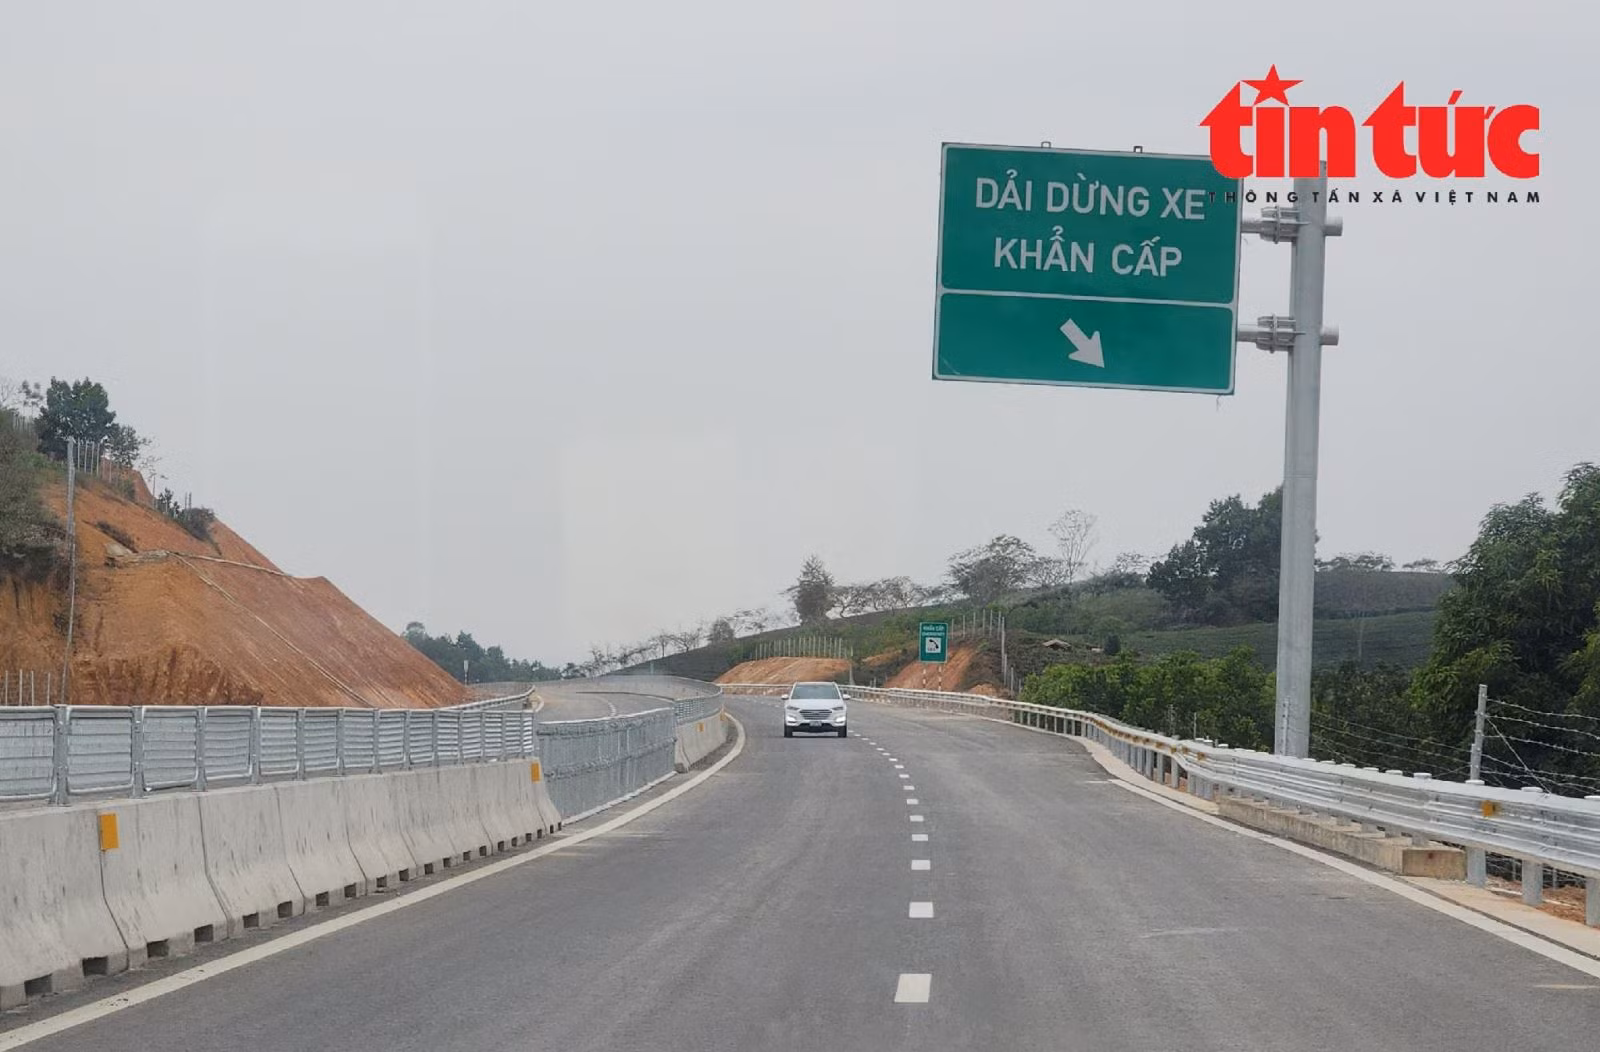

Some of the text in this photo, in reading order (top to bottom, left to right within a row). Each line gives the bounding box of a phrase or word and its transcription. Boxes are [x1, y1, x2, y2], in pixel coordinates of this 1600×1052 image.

[975, 168, 1206, 221] DẢI DỪNG XE
[993, 225, 1183, 279] KHẨN CẤP
